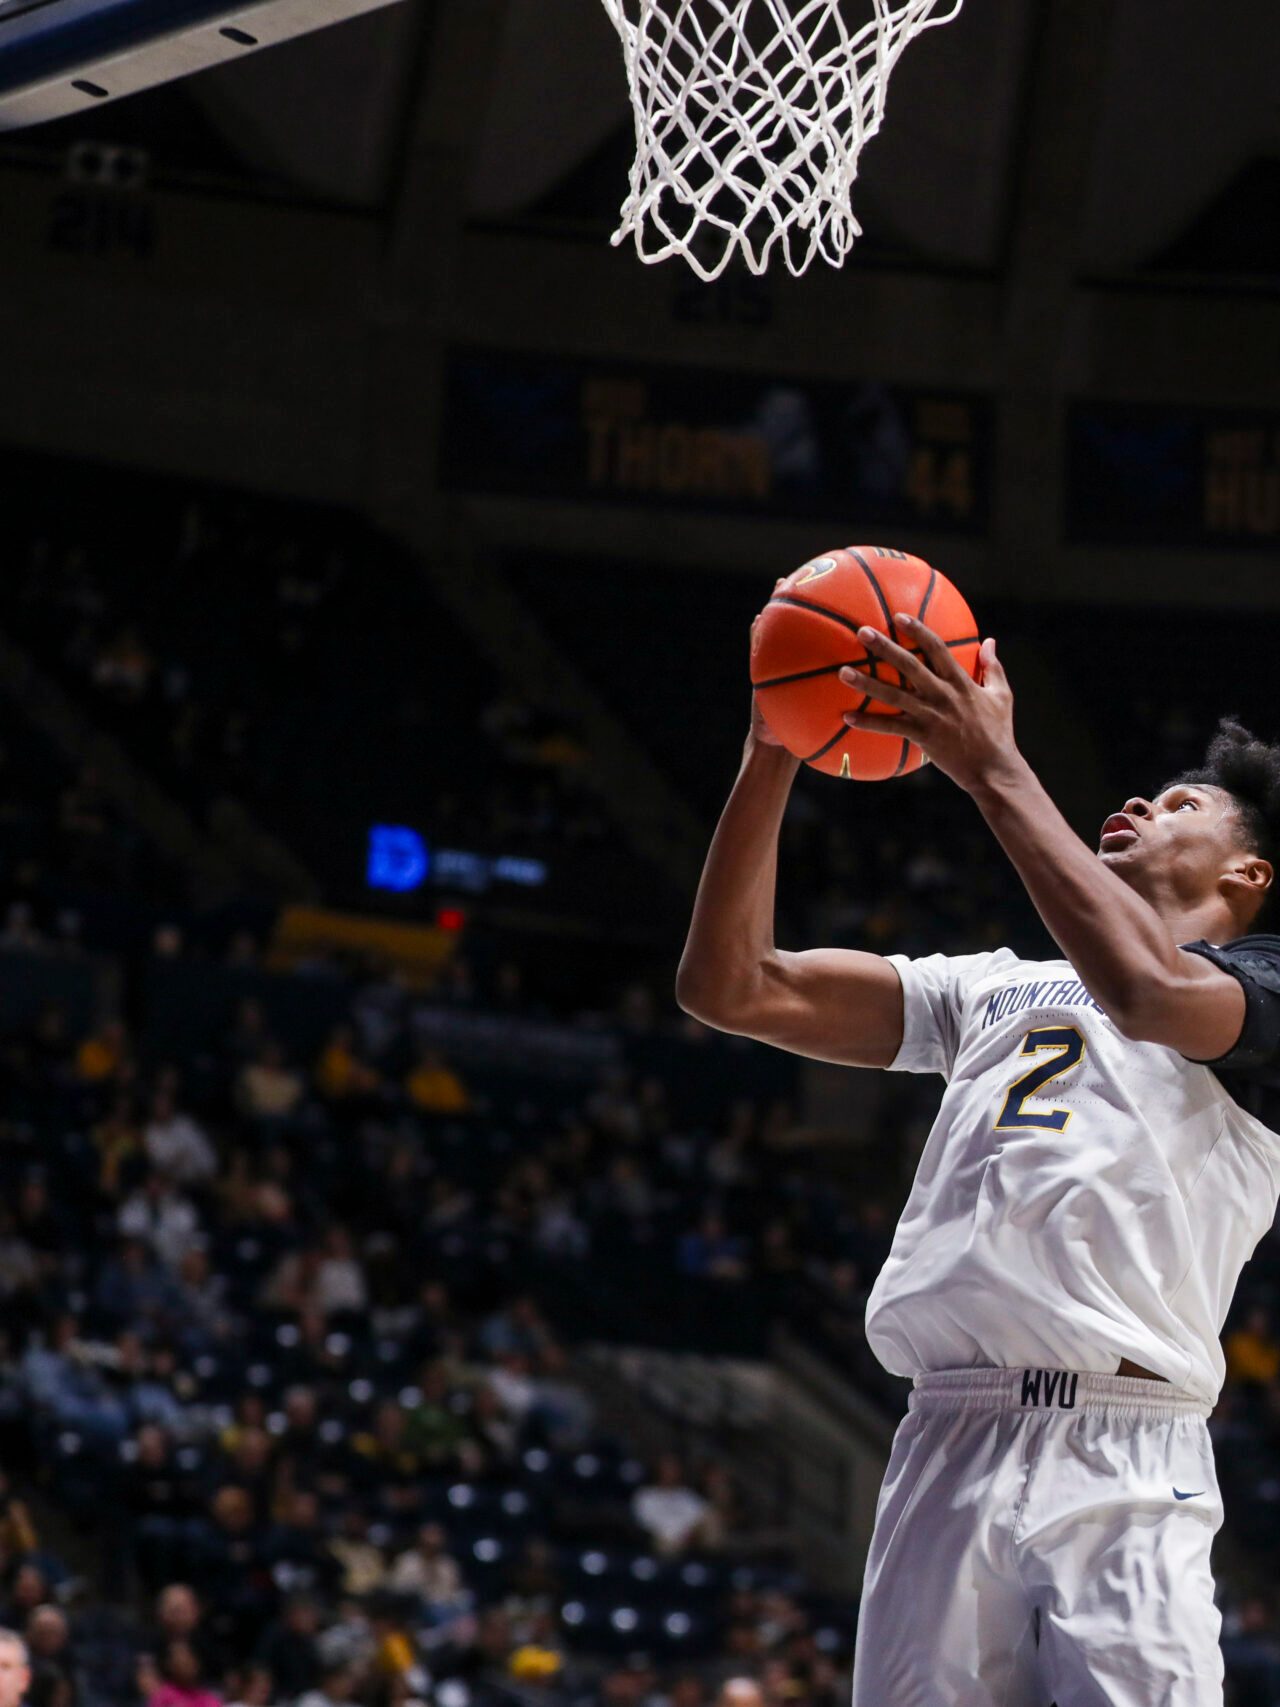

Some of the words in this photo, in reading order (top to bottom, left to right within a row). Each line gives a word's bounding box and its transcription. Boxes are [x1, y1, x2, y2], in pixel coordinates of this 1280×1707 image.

[48, 191, 157, 260] 214
[584, 414, 771, 499] THORN
[906, 446, 974, 519] 44
[993, 1025, 1087, 1134] 2
[1021, 1369, 1078, 1409] WVU
